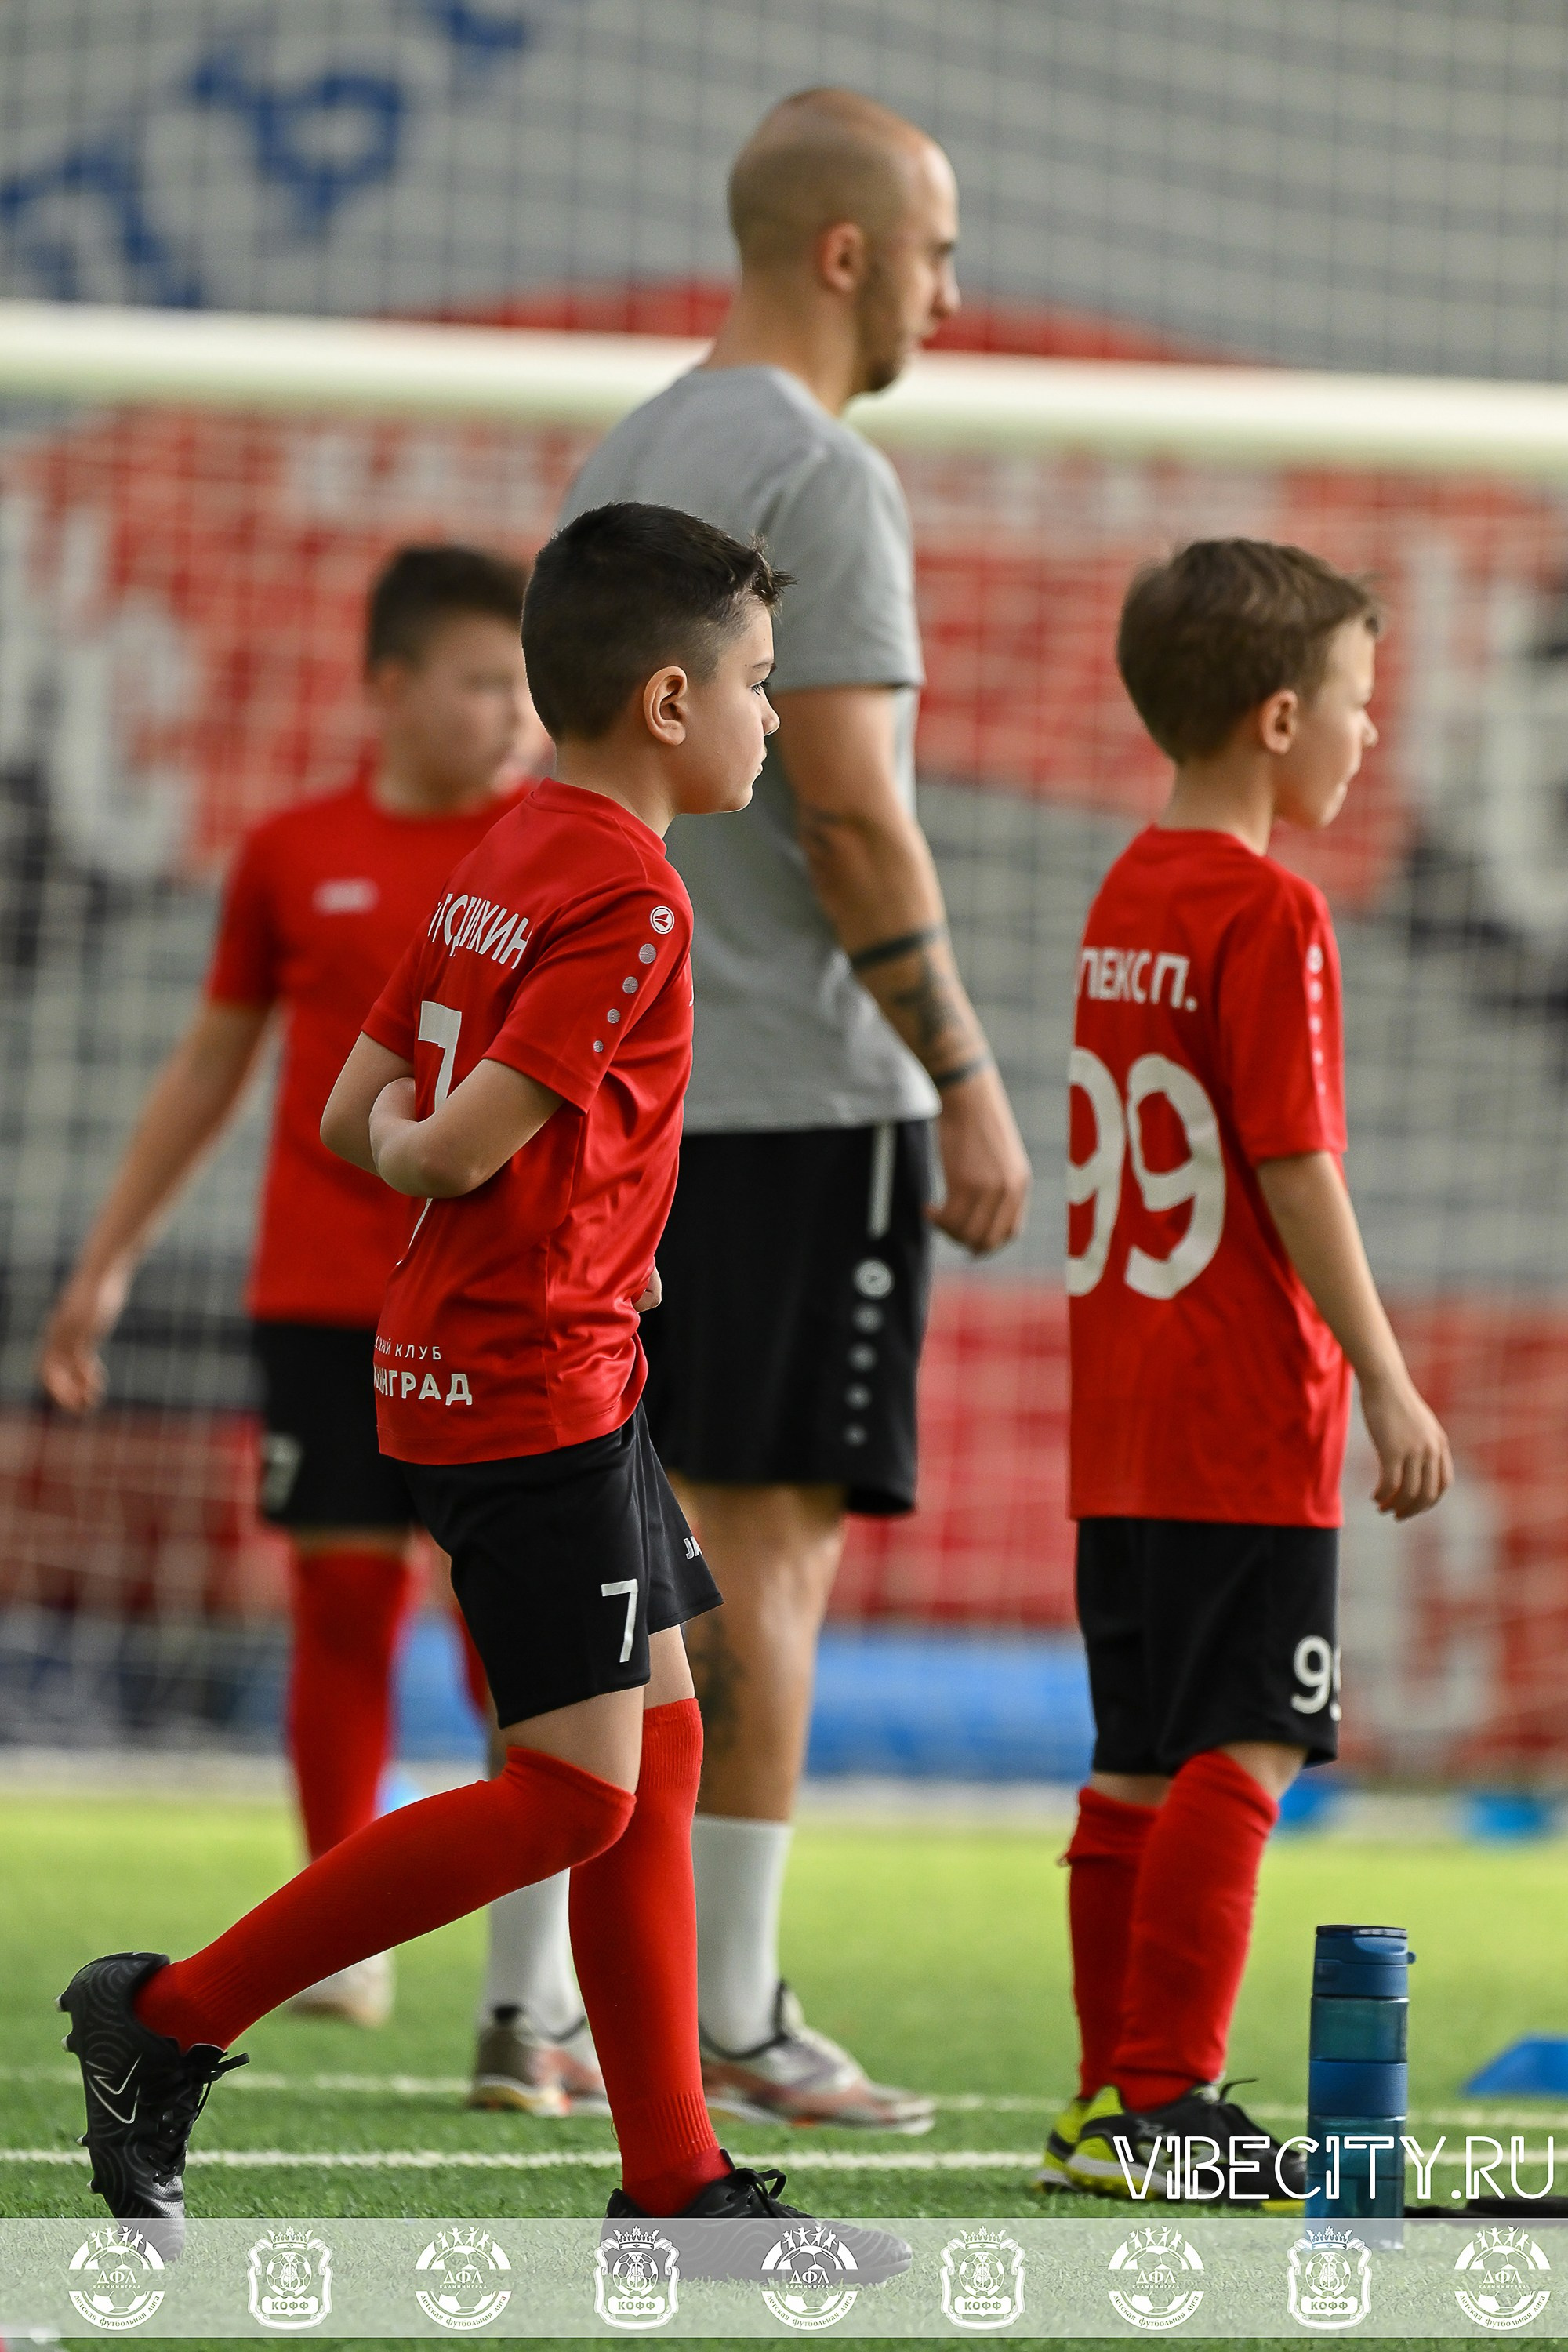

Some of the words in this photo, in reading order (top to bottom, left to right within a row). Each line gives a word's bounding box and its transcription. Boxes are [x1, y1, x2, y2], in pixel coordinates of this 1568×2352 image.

[1067, 1046, 1226, 1300] 99
[394, 1343, 441, 1360] КЛУБ
[601, 1578, 639, 1663] 7
